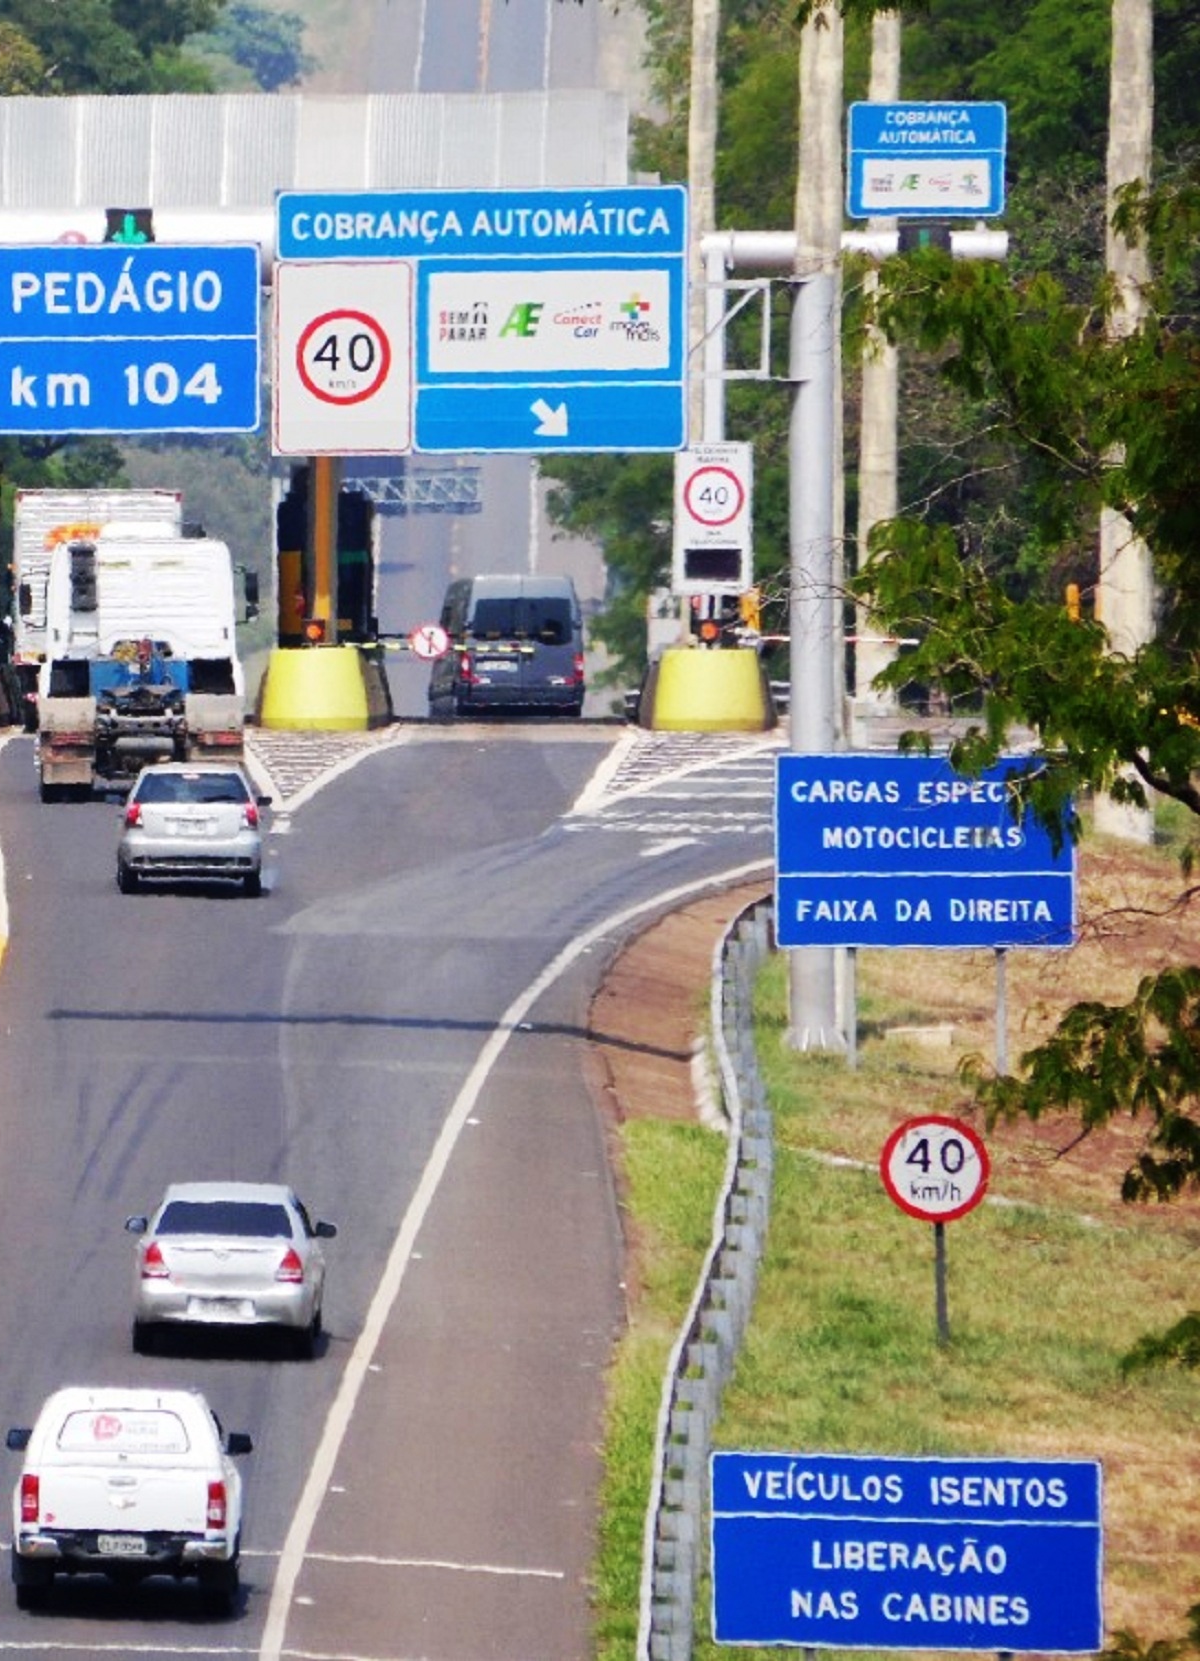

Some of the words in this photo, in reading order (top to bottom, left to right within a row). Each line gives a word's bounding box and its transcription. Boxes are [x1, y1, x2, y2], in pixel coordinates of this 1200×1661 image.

[878, 128, 976, 144] AUTOMÁTICA
[885, 110, 970, 128] COBRANÇA
[291, 210, 463, 245] COBRANÇA
[471, 200, 670, 238] AUTOMÁTICA
[12, 256, 222, 314] PEDÁGIO
[312, 333, 375, 372] 40
[11, 365, 90, 407] km
[124, 361, 222, 406] 104
[699, 486, 729, 505] 40
[790, 780, 900, 803] CARGAS
[918, 780, 1008, 804] ESPEC
[796, 899, 877, 923] FAIXA
[896, 899, 932, 923] DA
[951, 899, 1053, 923] DIREITA
[905, 1138, 965, 1174] 40
[910, 1180, 961, 1201] km/h
[743, 1463, 903, 1503] VEÍCULOS
[930, 1477, 1068, 1508] ISENTOS
[812, 1539, 1007, 1576] LIBERAÇÃO
[791, 1590, 859, 1620] NAS
[882, 1592, 1030, 1626] CABINES
